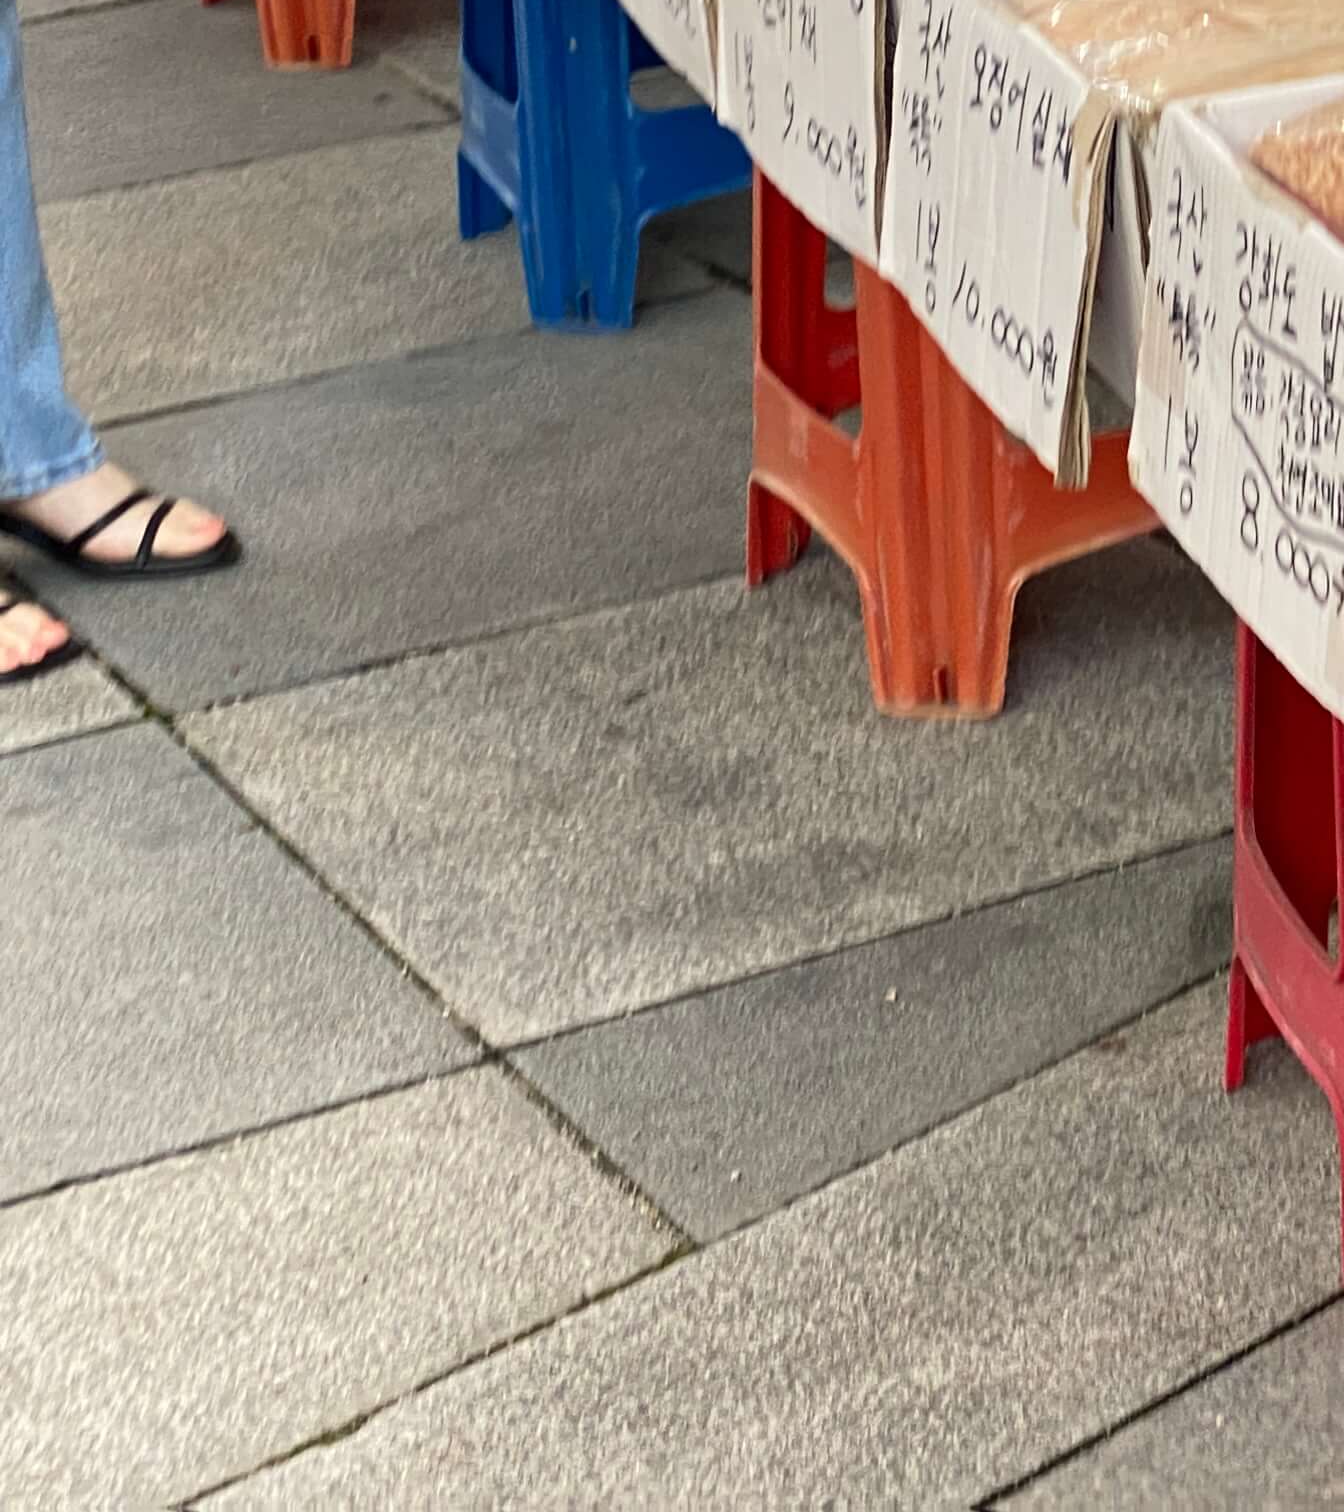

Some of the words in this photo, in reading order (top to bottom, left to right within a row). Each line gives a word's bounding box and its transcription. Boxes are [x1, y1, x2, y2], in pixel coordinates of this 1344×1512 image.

[1167, 168, 1208, 277] 국산
[915, 199, 941, 314] 1봉
[952, 262, 1058, 406] 10.000원
[1164, 393, 1199, 514] 1봉
